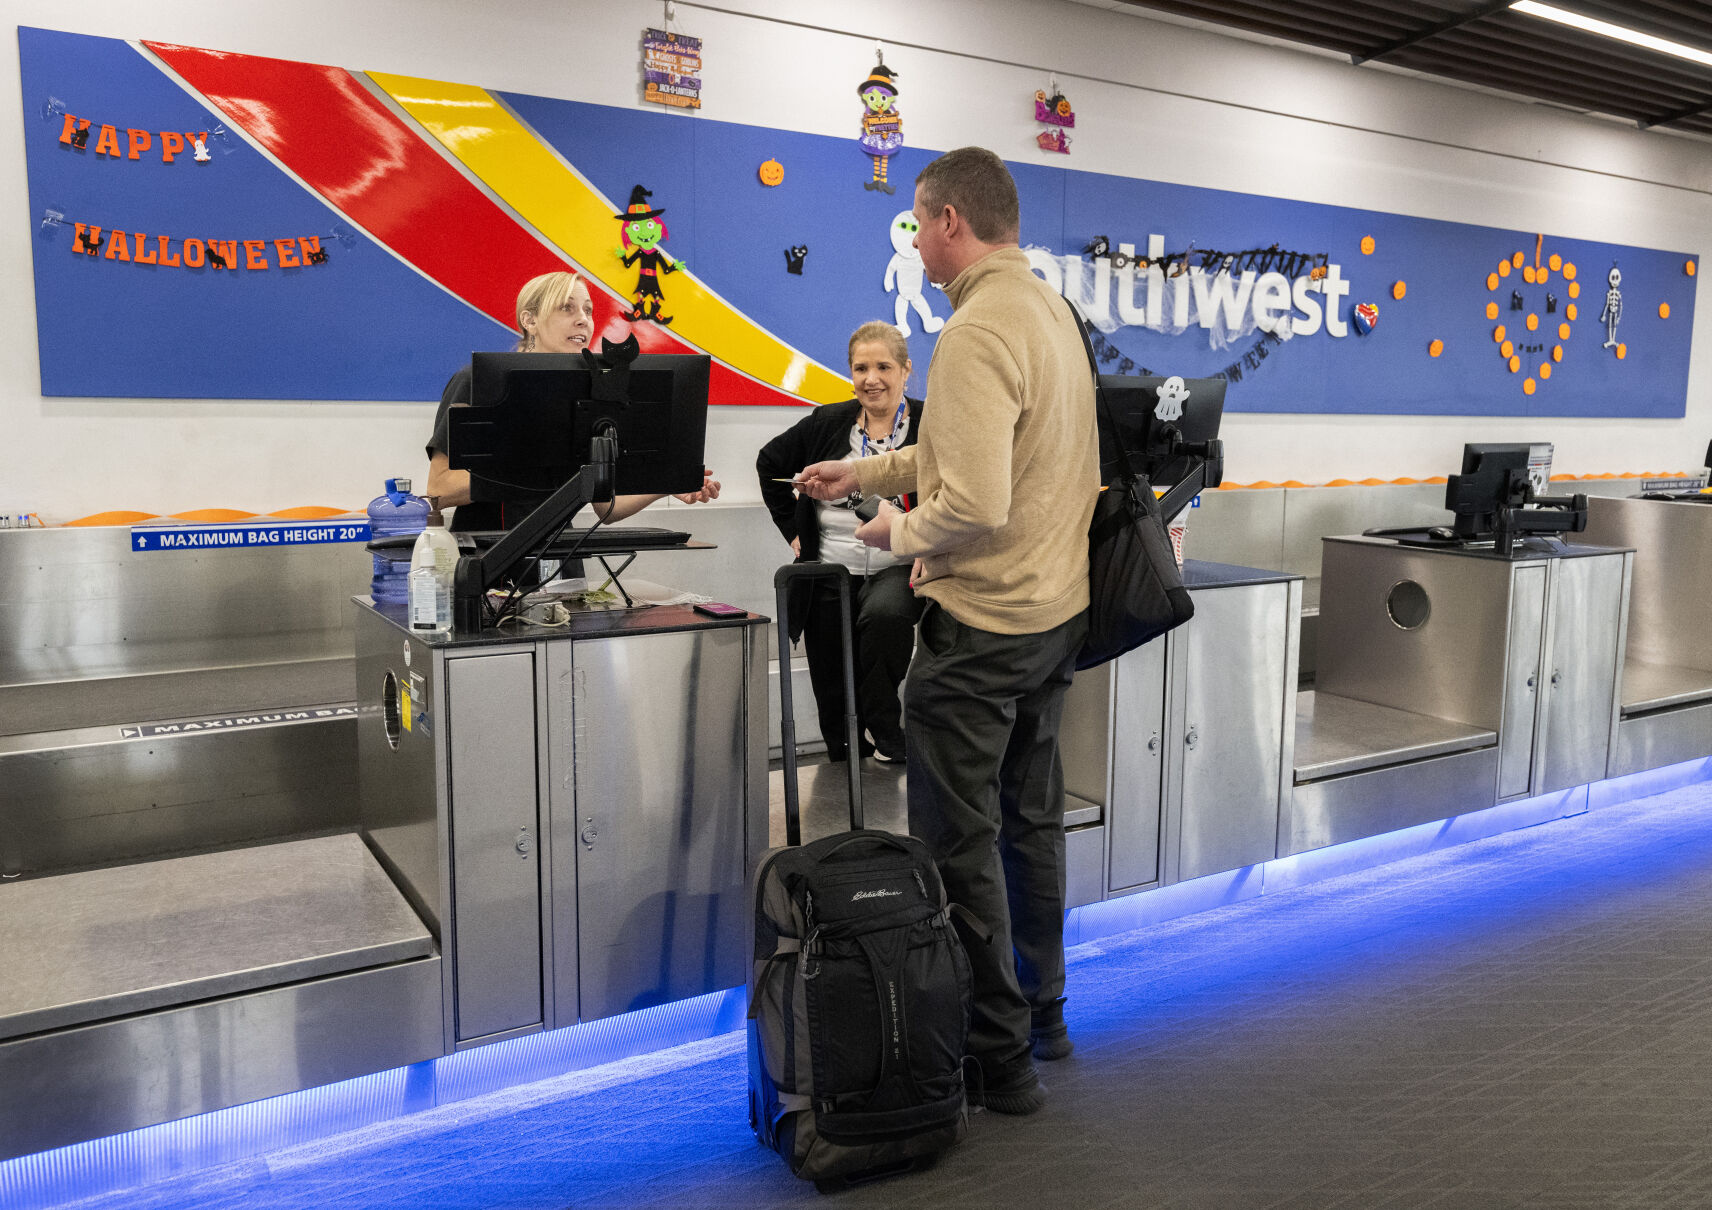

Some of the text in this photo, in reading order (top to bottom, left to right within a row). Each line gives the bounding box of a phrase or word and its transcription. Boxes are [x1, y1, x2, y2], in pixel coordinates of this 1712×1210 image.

[59, 113, 209, 162] HAPPY
[72, 222, 327, 270] HALLOWEEN
[1021, 233, 1350, 338] outhwest
[160, 532, 243, 547] MAXIMUM
[248, 530, 280, 544] BAG
[283, 528, 336, 542] HEIGHT
[154, 711, 309, 734] MAXIMUM
[888, 981, 899, 1043] EXPEDITION
